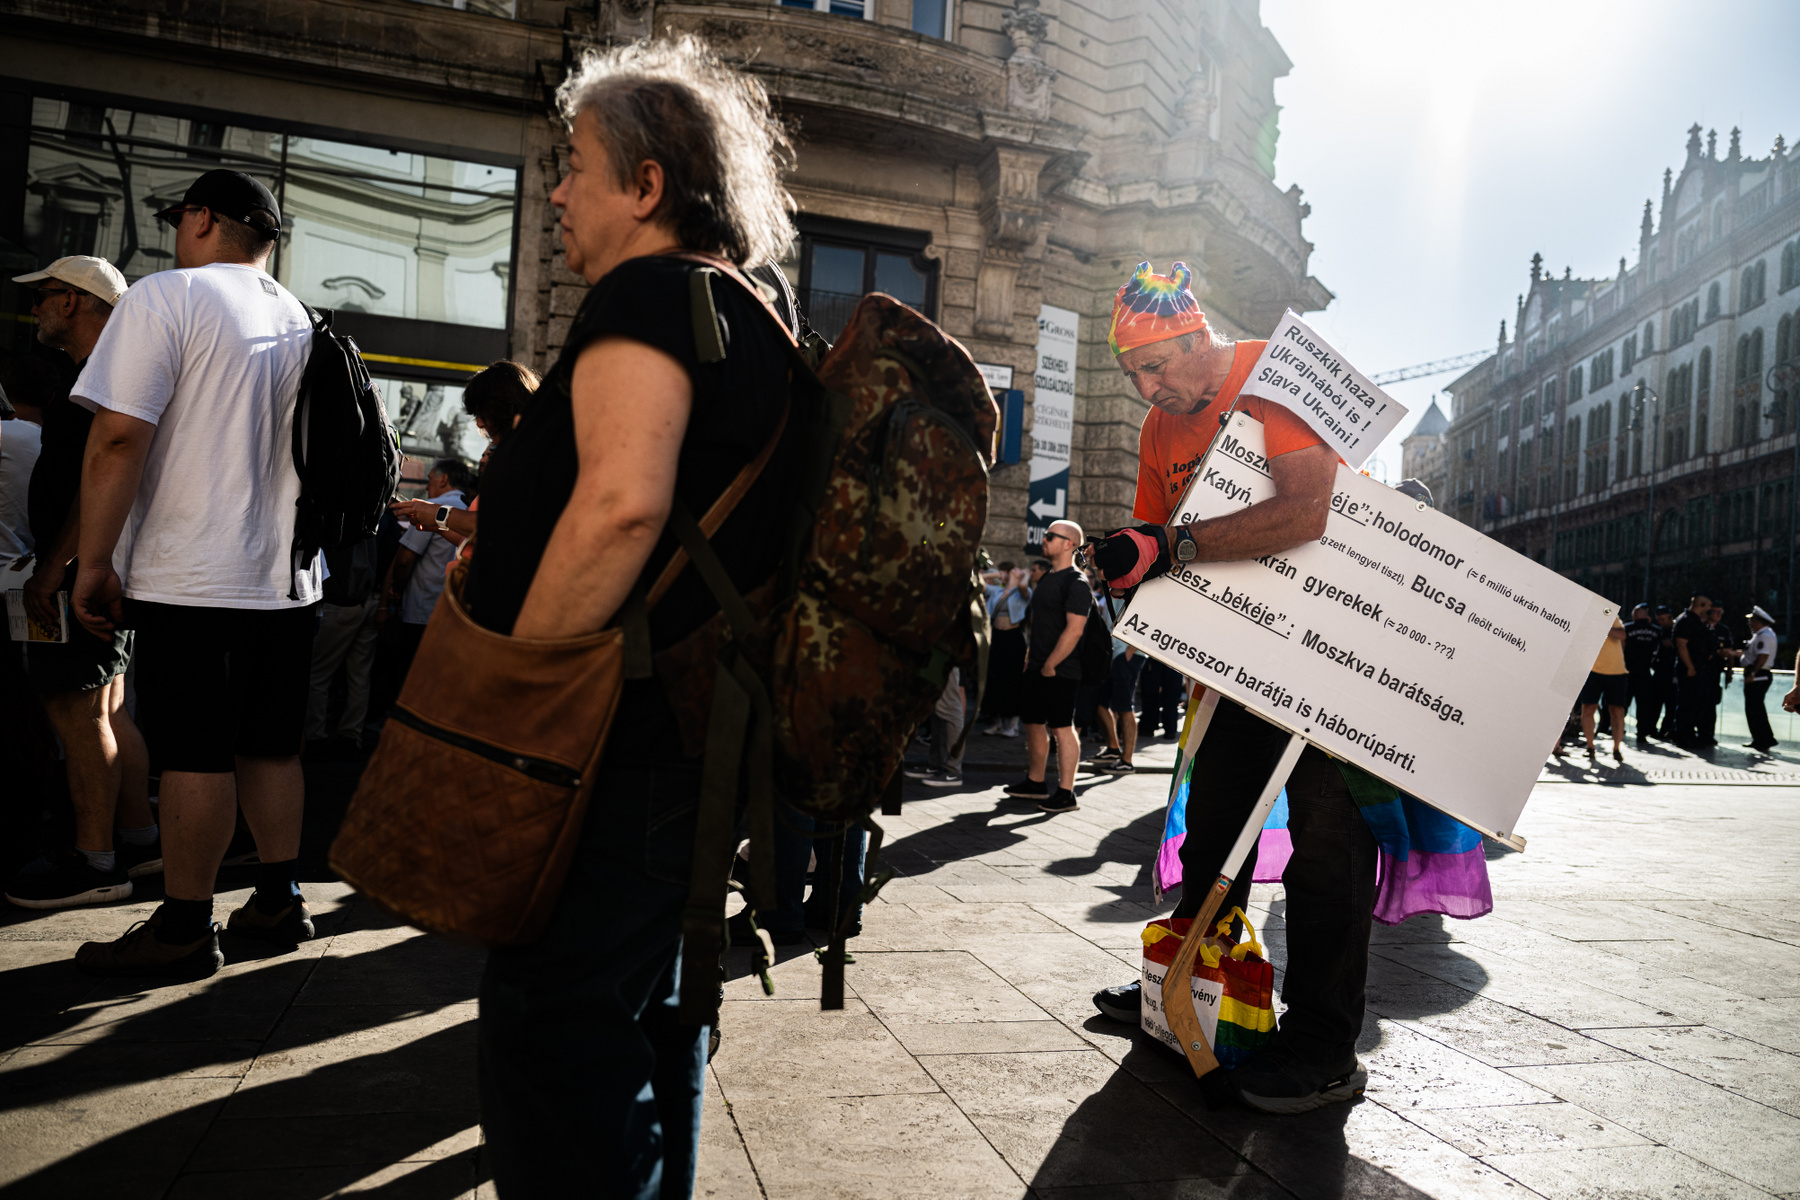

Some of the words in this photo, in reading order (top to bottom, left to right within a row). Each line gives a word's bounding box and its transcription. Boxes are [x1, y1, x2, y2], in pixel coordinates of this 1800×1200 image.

[1258, 367, 1301, 396] Slava
[1302, 392, 1360, 449] Ukraini!
[1269, 344, 1348, 410] Ukrajnából
[1345, 406, 1361, 424] is
[1284, 325, 1343, 378] Ruszkik
[1340, 373, 1376, 409] haza
[1220, 434, 1270, 474] Moszk
[1372, 511, 1465, 570] holodomor
[1479, 574, 1487, 584] 6
[1486, 578, 1512, 598] millió
[1512, 594, 1540, 613] ukrán
[1539, 607, 1571, 633] halott),
[1168, 563, 1211, 593] desz
[1301, 629, 1376, 680] Moszkva
[1377, 668, 1465, 726] barátsága.
[1254, 554, 1297, 580] krán
[1302, 575, 1384, 622] gyerekek
[1395, 623, 1409, 635] 20
[1409, 629, 1427, 644] 000
[1318, 535, 1346, 553] gzett
[1346, 547, 1381, 570] lengyel
[1381, 565, 1405, 586] tiszt),
[1410, 574, 1467, 616] Bucsa
[1467, 612, 1492, 632] (leölt
[1492, 627, 1526, 653] civilek),
[1124, 613, 1149, 636] Az
[1150, 629, 1234, 677] agresszor
[1235, 667, 1293, 707] barátja
[1296, 698, 1312, 718] is
[1314, 707, 1416, 774] háborúpárti.
